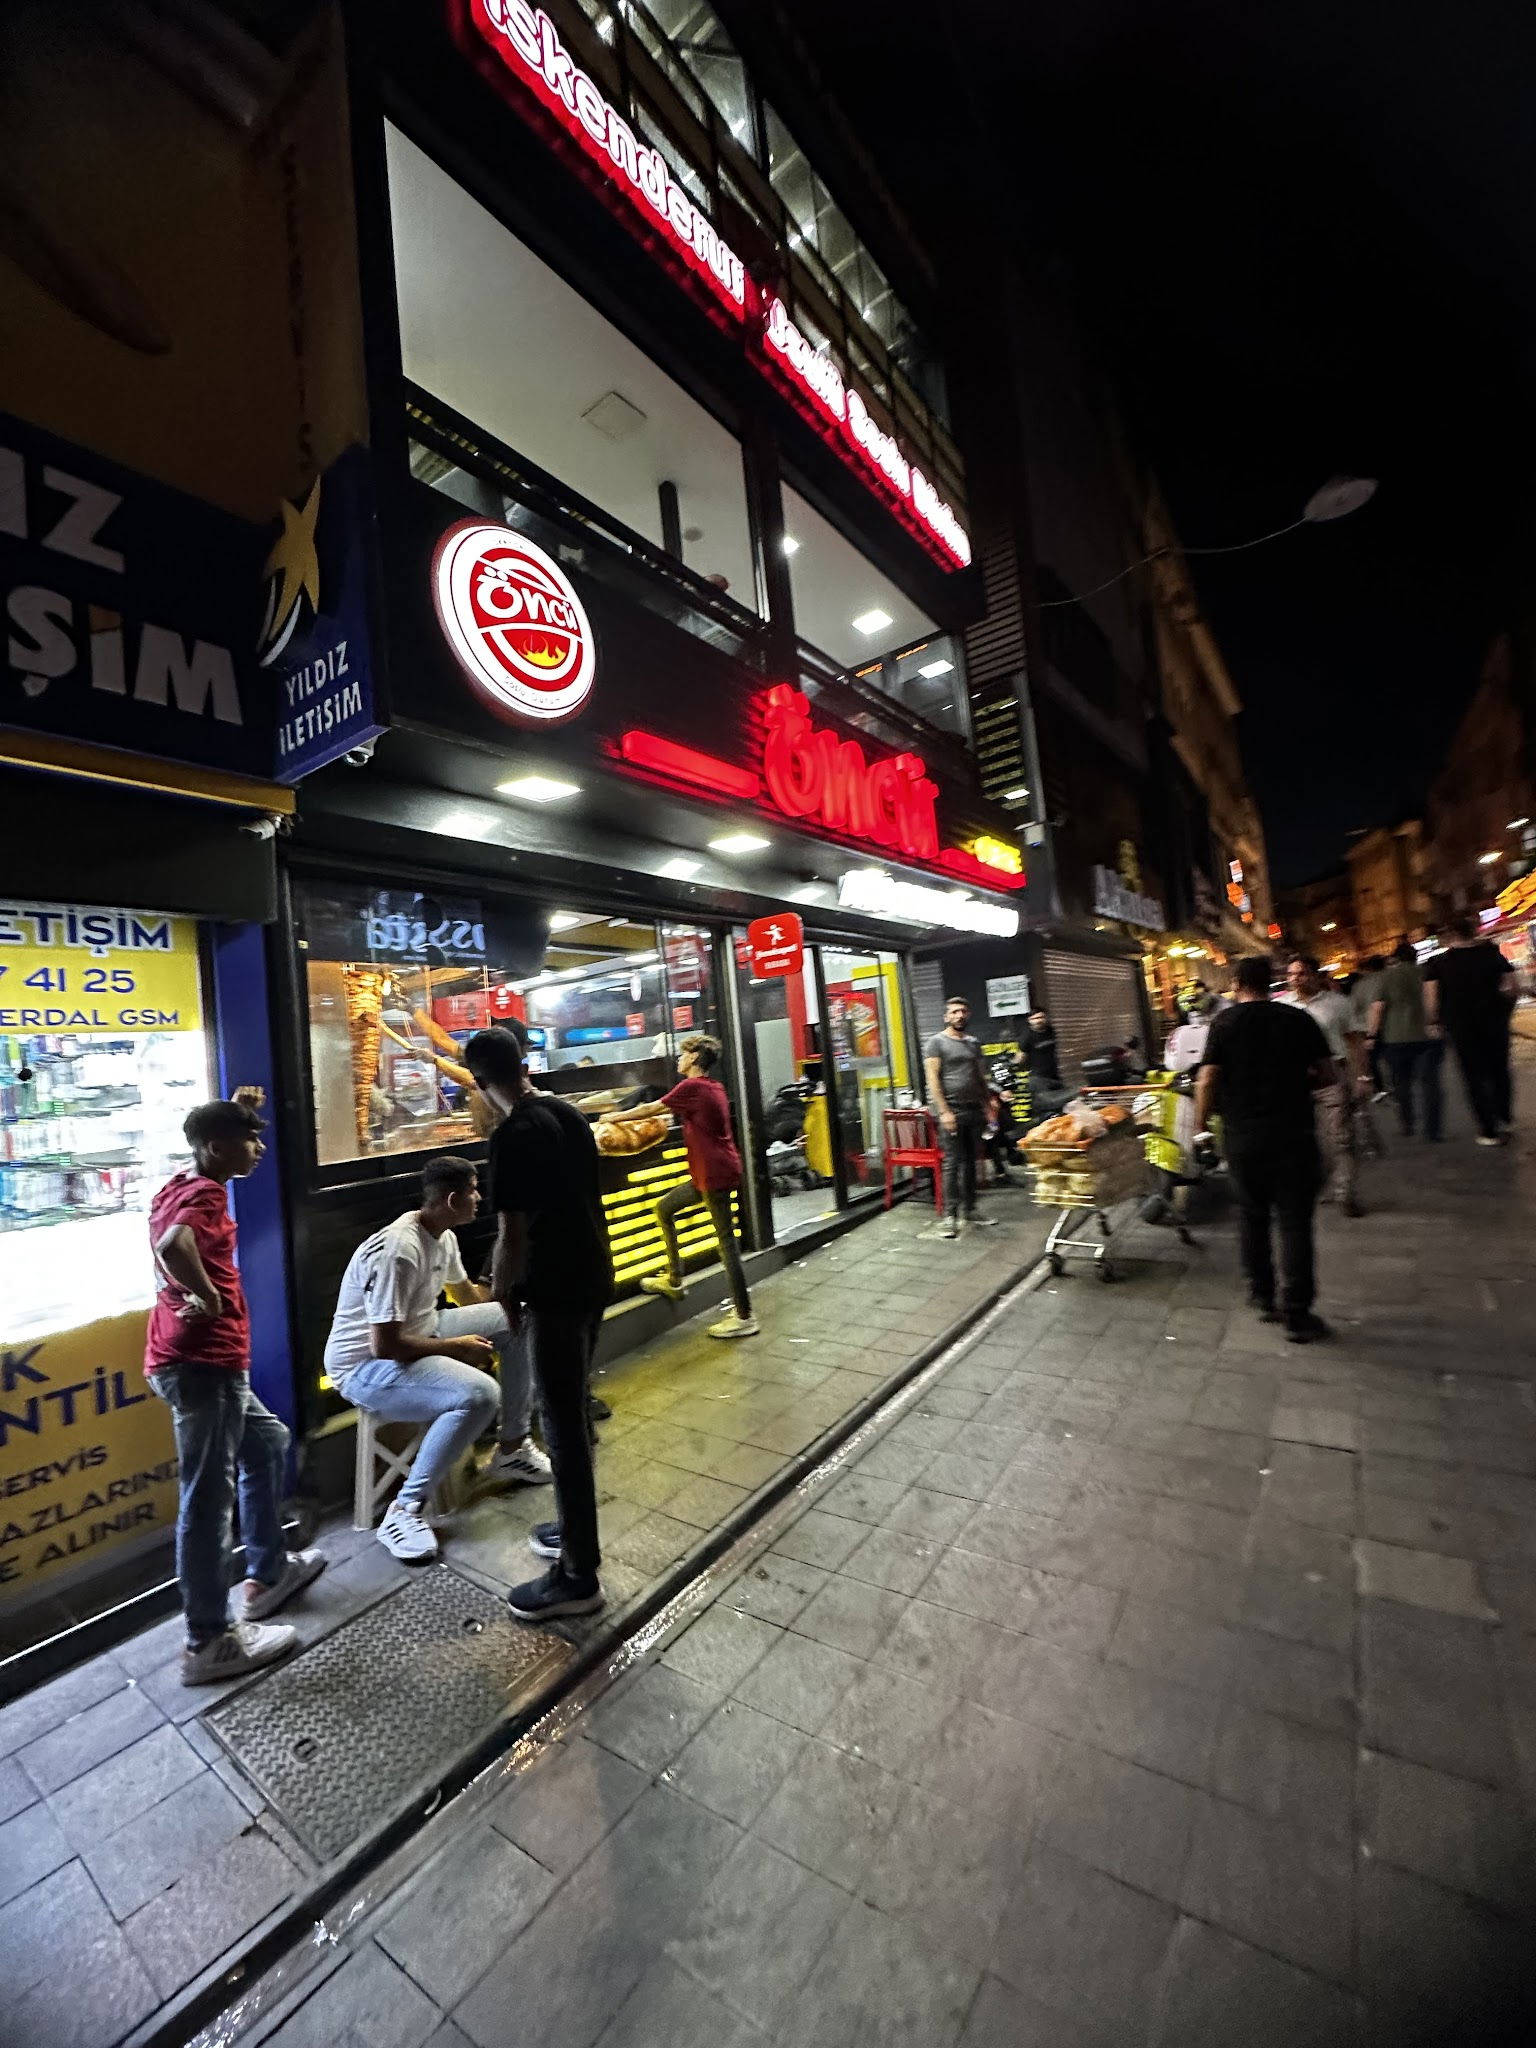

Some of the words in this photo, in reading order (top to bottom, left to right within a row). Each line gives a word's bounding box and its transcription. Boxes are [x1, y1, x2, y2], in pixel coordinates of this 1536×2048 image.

[7, 586, 244, 726] ŞİM
[285, 640, 349, 706] YILDIZ
[24, 967, 67, 993] 41
[83, 968, 136, 993] 25
[0, 1008, 108, 1026] ERDAL
[118, 1009, 179, 1026] GSM
[2, 1343, 51, 1392] K
[0, 1366, 157, 1447] NTİL
